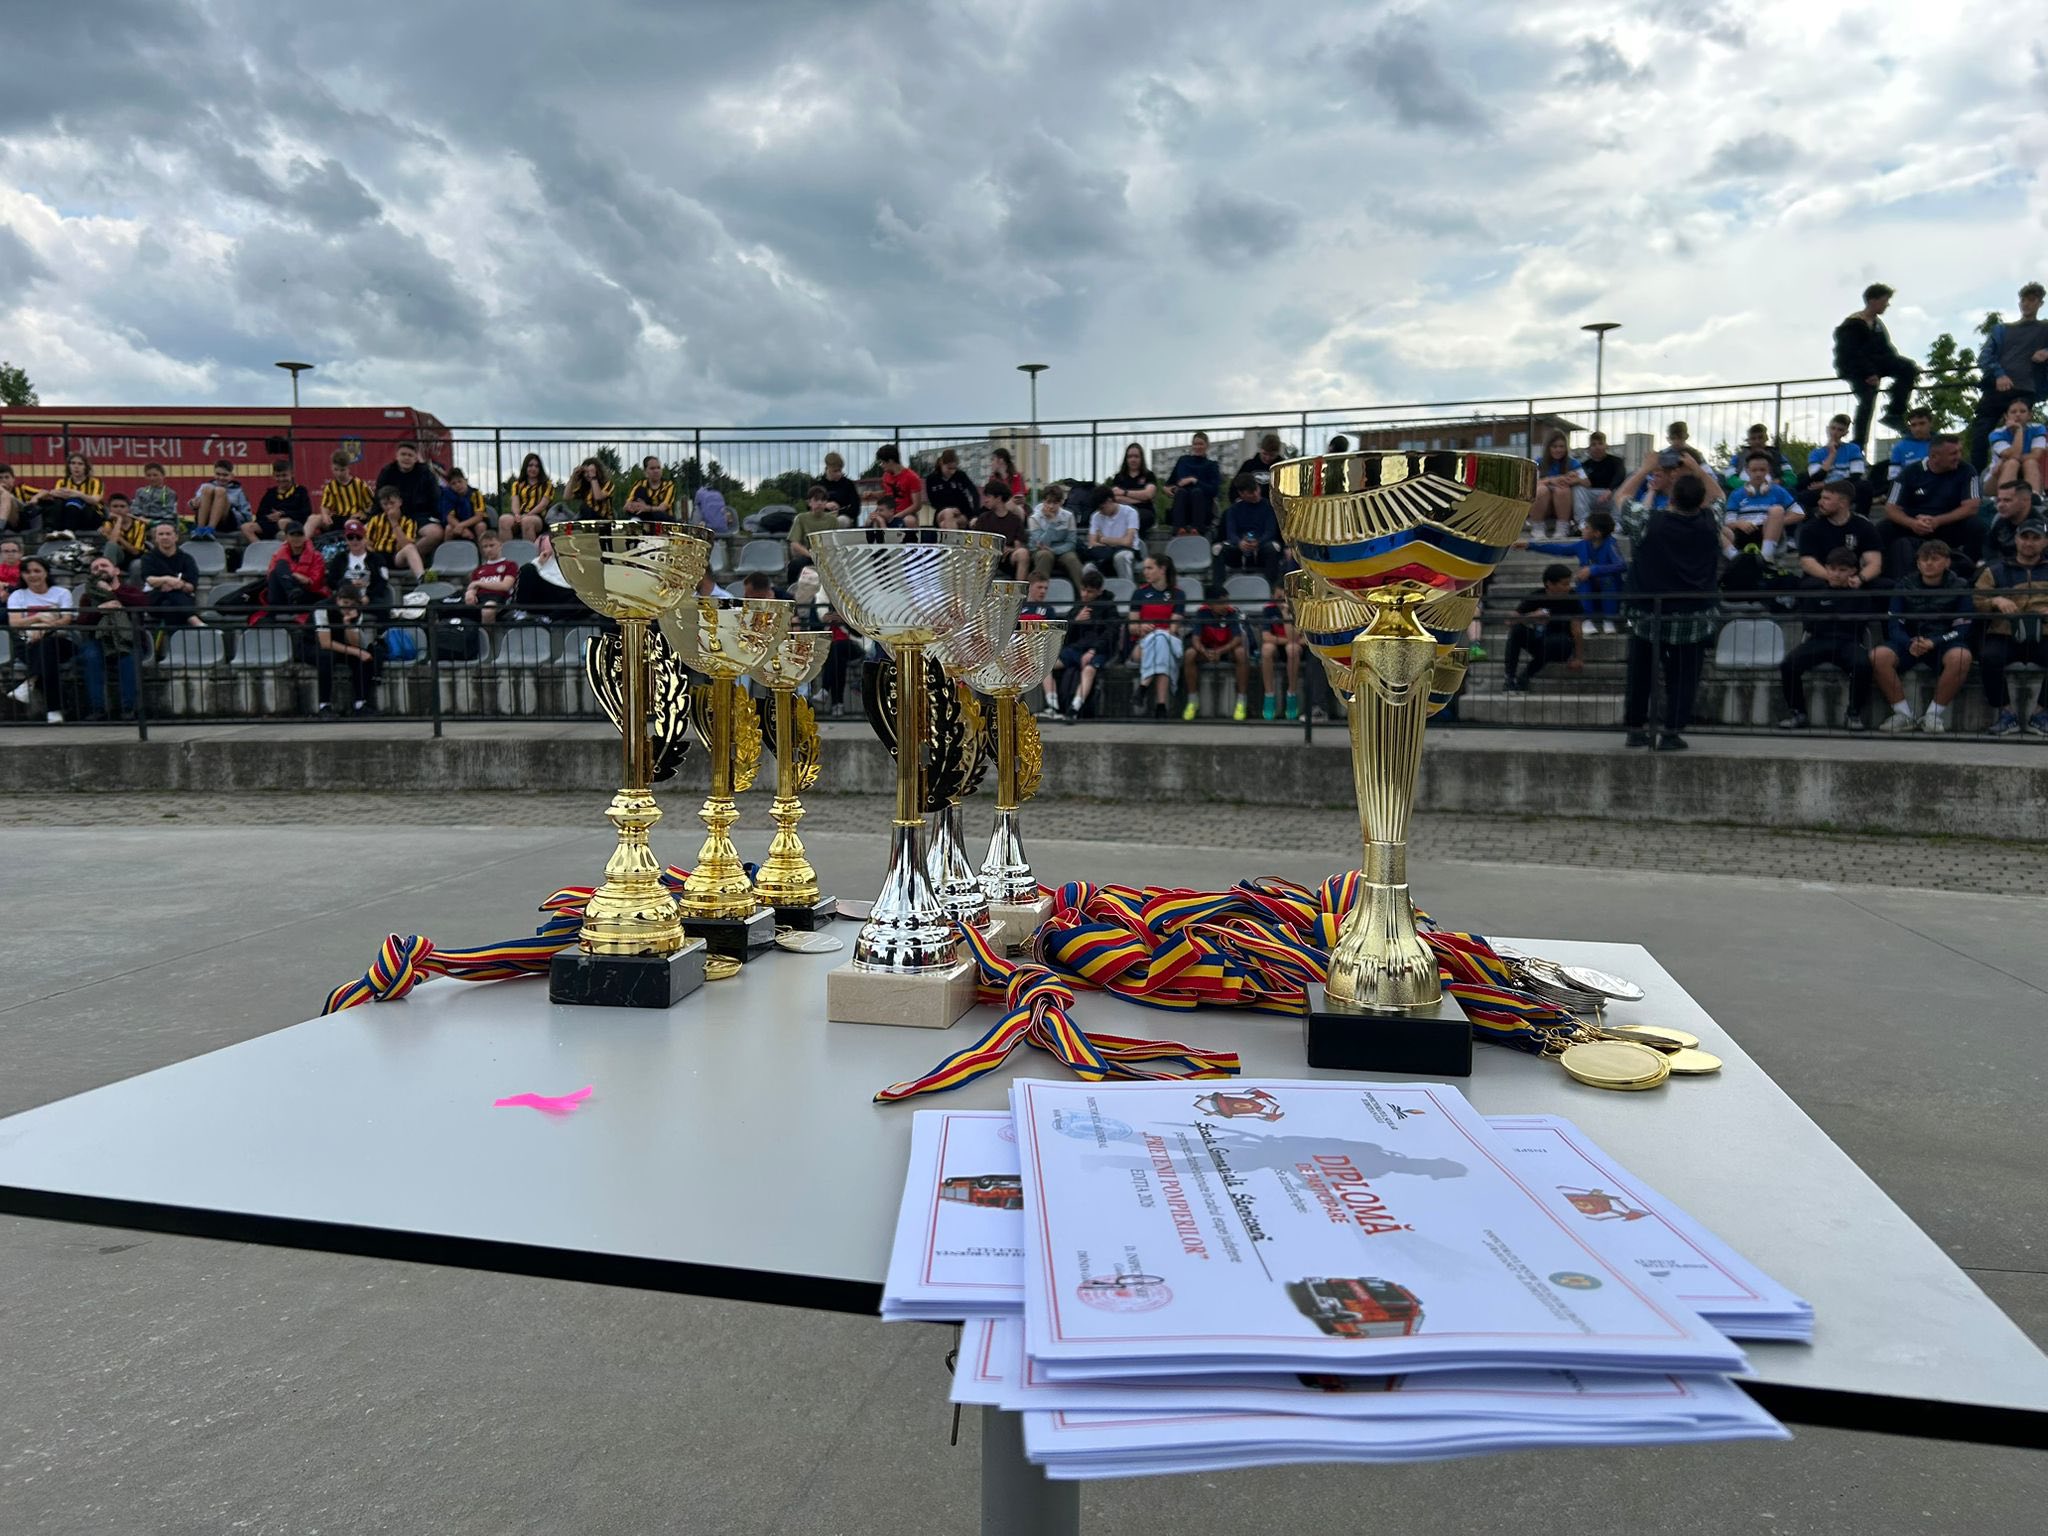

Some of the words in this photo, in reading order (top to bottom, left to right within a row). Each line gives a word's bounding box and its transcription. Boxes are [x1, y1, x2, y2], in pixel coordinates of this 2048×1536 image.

[48, 437, 182, 457] POMPIERII
[216, 441, 247, 456] 112
[1294, 1163, 1316, 1174] DE
[1302, 1174, 1350, 1223] PARTICIPARE
[1312, 1155, 1415, 1235] DIPLOMĂ
